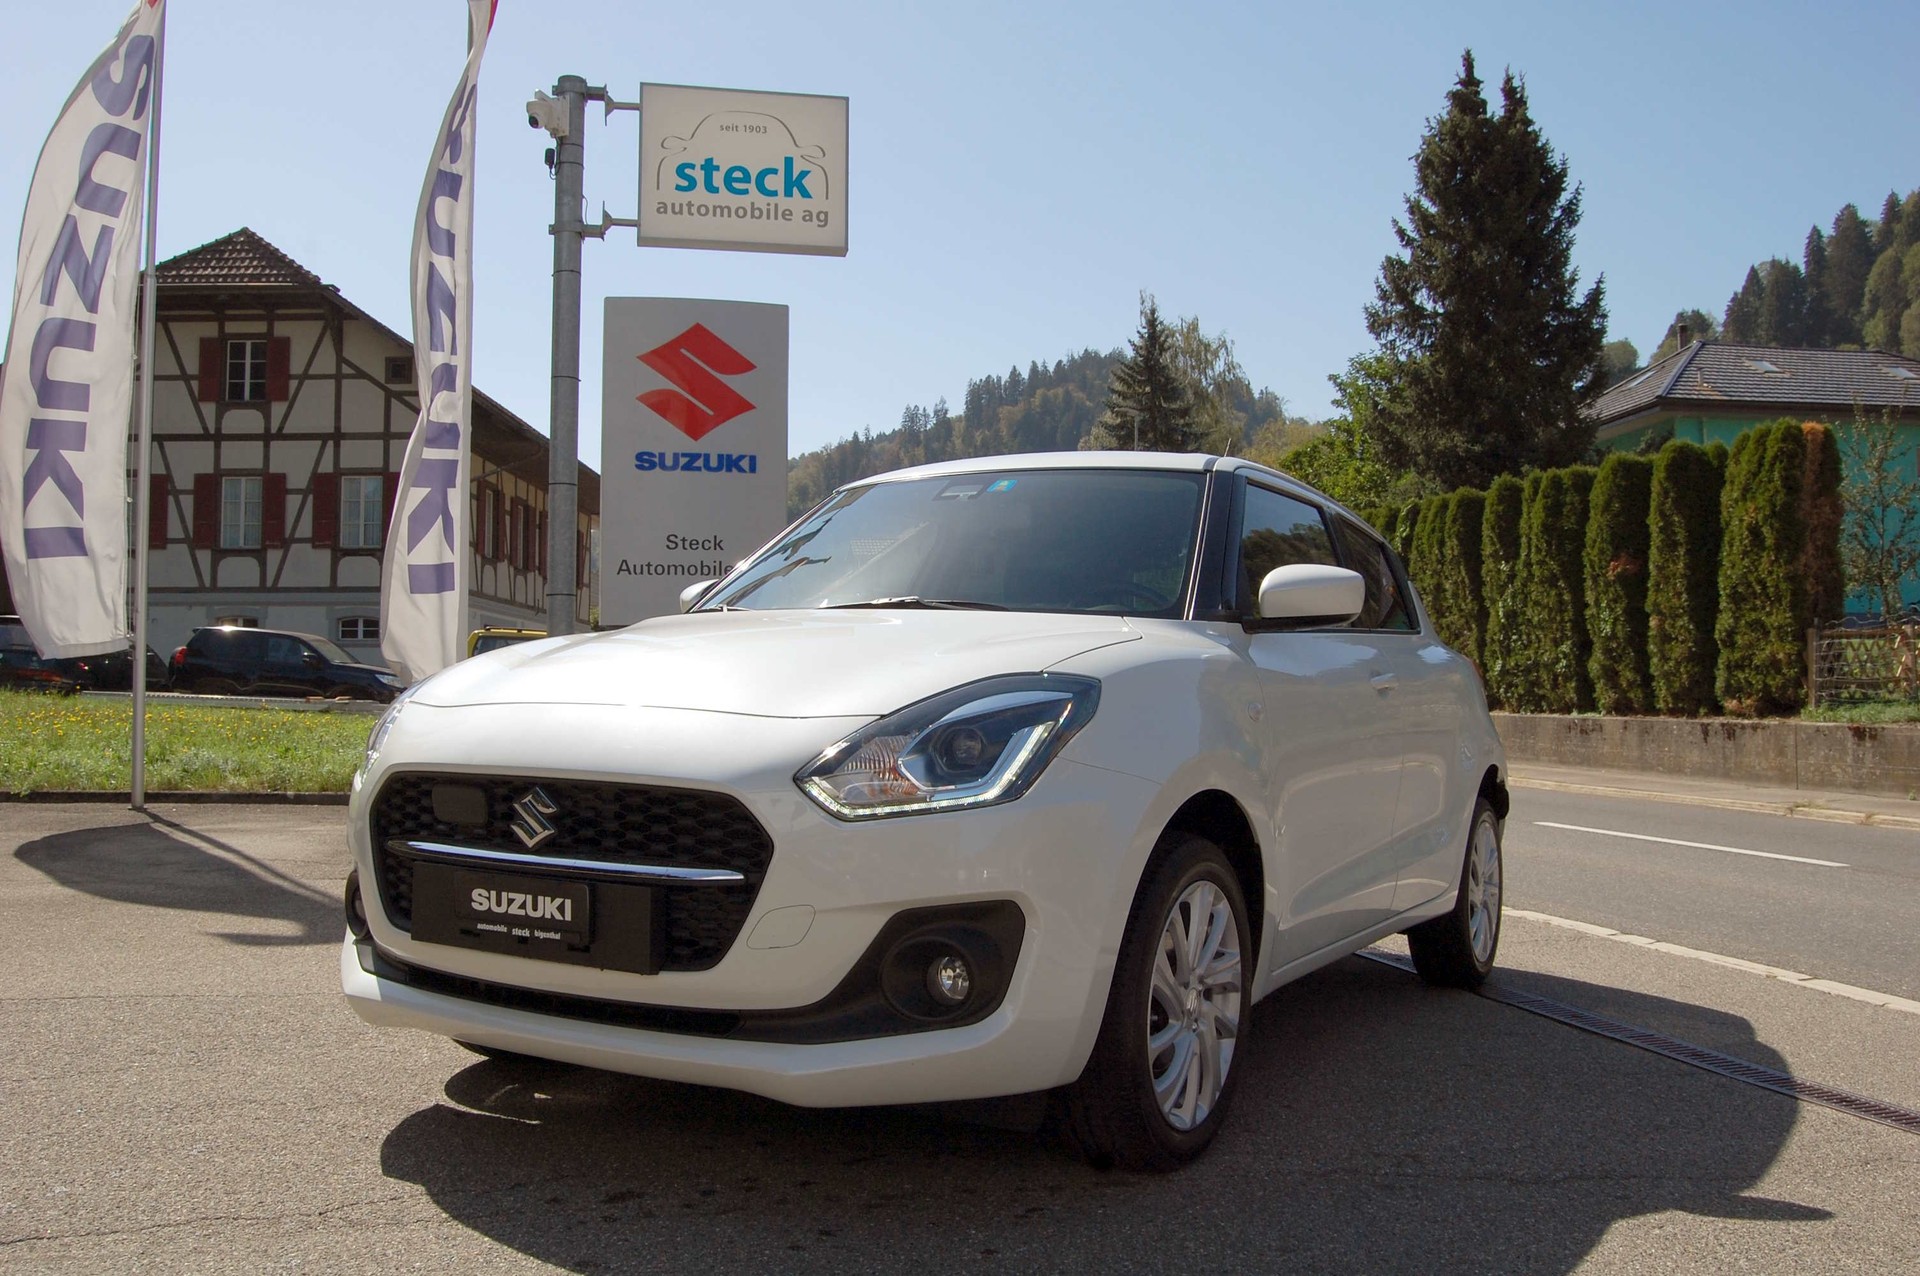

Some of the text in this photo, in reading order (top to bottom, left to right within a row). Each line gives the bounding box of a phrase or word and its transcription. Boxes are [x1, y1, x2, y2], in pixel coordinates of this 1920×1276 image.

[719, 123, 768, 134] seit 1903
[674, 155, 813, 199] steck
[655, 200, 829, 228] automobile ag
[23, 34, 155, 559] SUZUKI
[634, 451, 757, 474] SUZUKI
[665, 534, 724, 551] Steck
[471, 888, 572, 921] SUZUKI
[477, 923, 507, 933] automobile
[512, 927, 530, 937] steck
